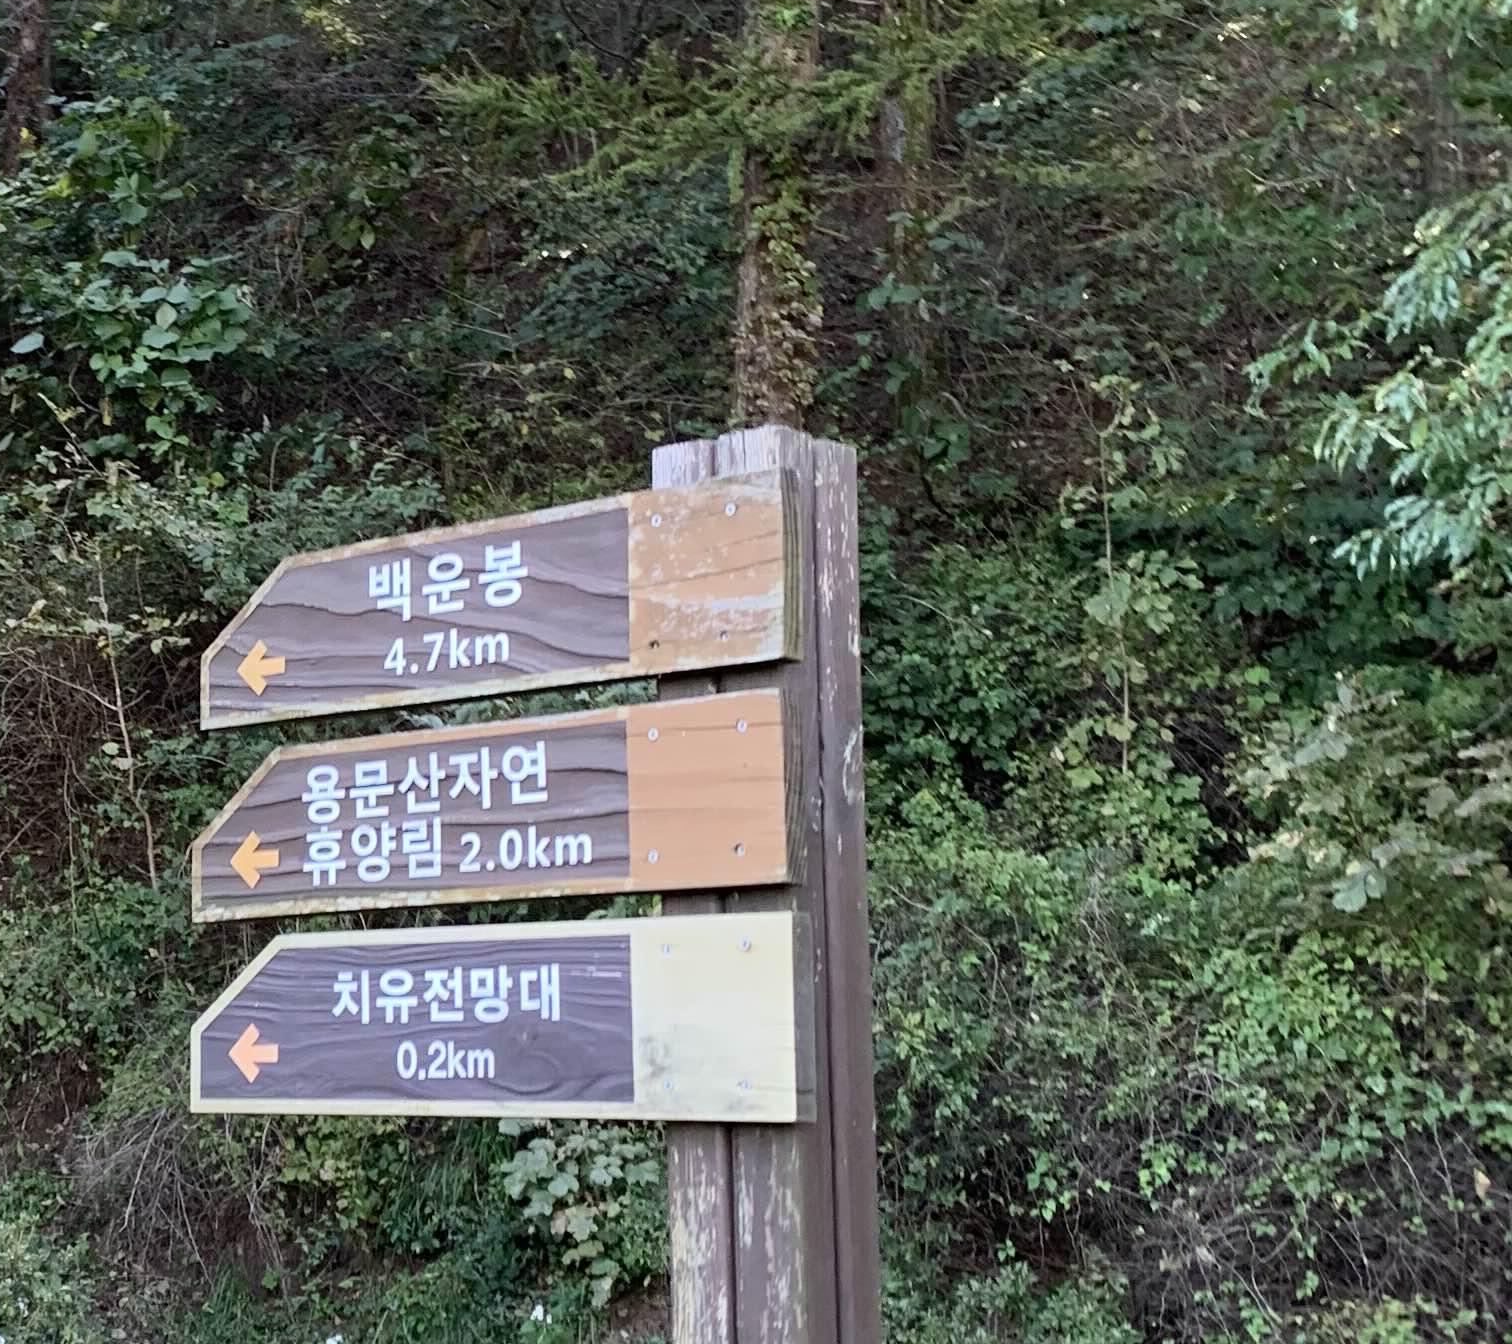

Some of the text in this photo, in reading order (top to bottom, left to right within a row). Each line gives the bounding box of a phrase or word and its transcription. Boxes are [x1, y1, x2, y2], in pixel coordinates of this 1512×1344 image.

[368, 540, 529, 621] 백운봉
[383, 628, 511, 677] 4.7km
[302, 741, 548, 825] 용문산자연
[303, 818, 594, 886] 휴양림 2.0km
[332, 962, 562, 1025] 치유전망대
[396, 1040, 496, 1081] 0.2km
